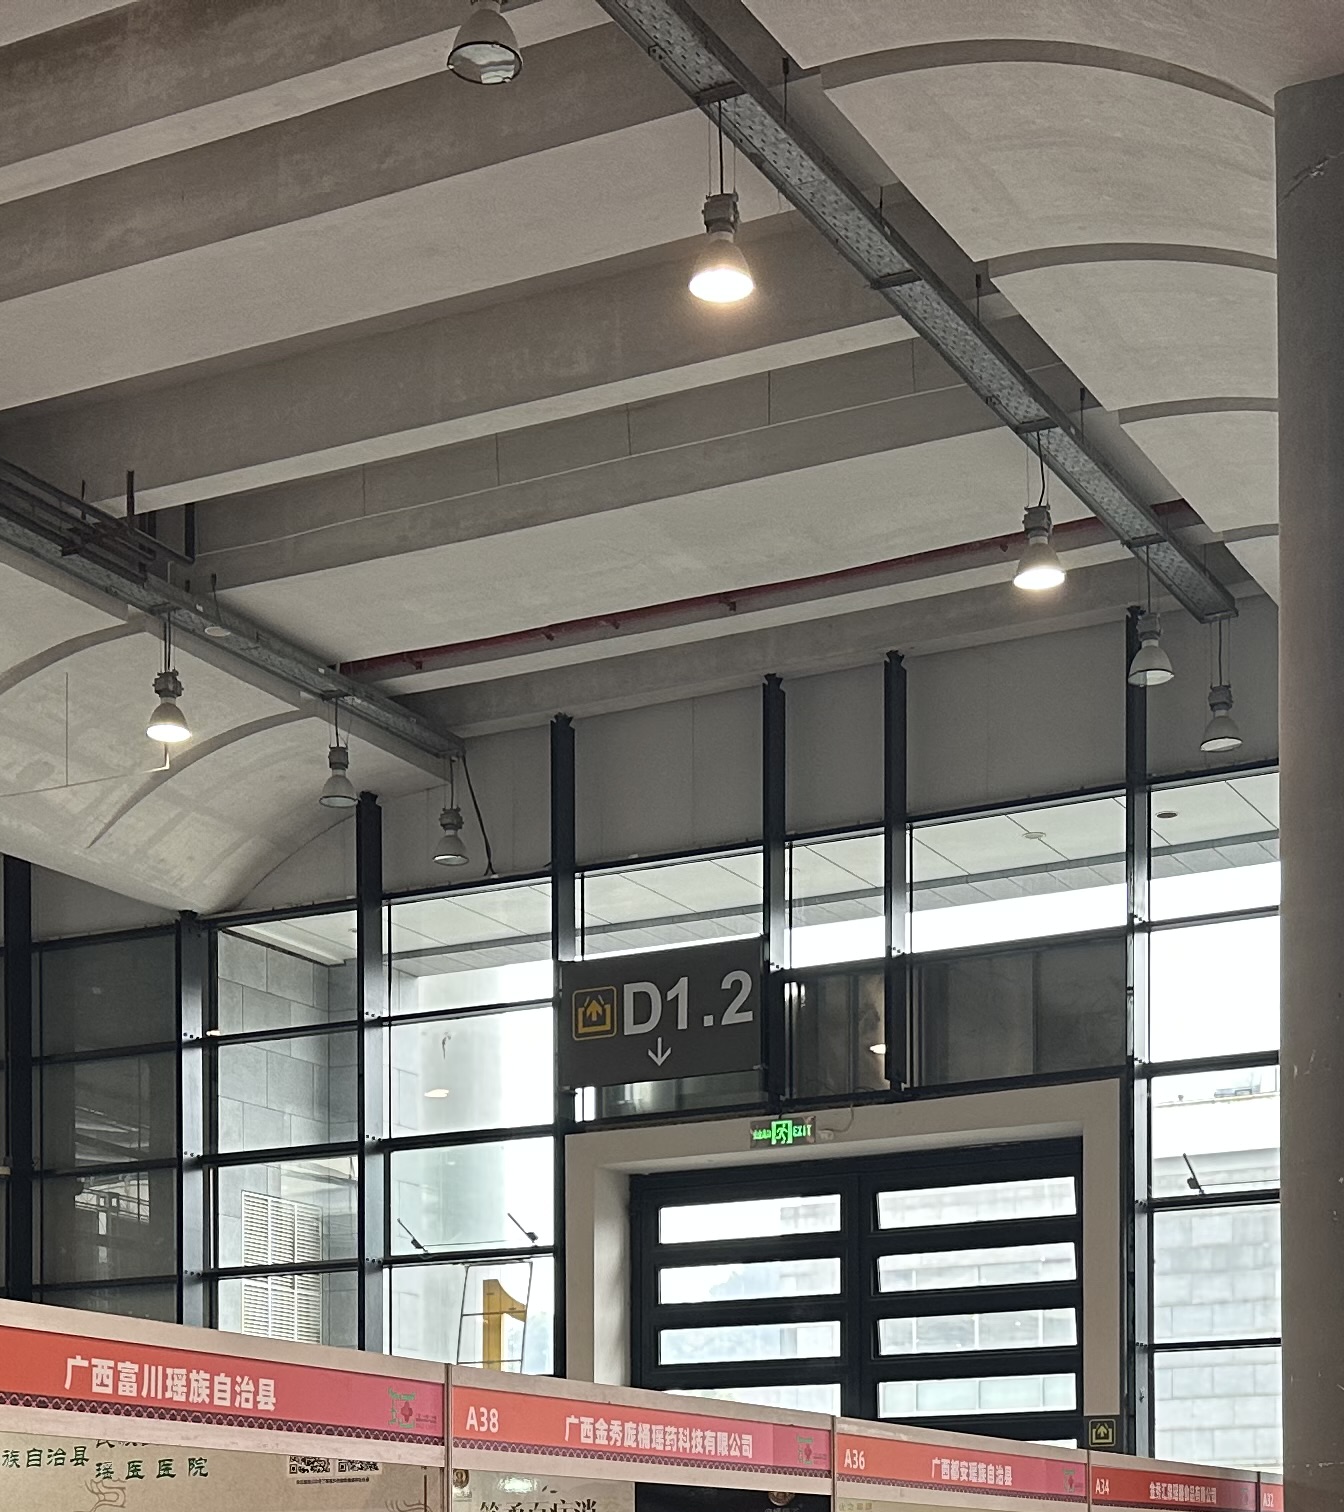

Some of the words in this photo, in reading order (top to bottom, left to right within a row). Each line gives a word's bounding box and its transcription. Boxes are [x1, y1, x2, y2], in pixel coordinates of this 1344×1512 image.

[623, 970, 754, 1036] D1.2
[793, 1124, 812, 1138] EXIT
[64, 1354, 278, 1412] 广西富川瑶族自治县
[465, 1405, 500, 1434] A38
[564, 1414, 754, 1459] 广西金秀庞桶瑶药科技有限公司
[94, 1456, 210, 1480] 瑶医医院
[843, 1448, 866, 1470] A36
[1095, 1478, 1110, 1496] A34
[1263, 1492, 1274, 1508] A32
